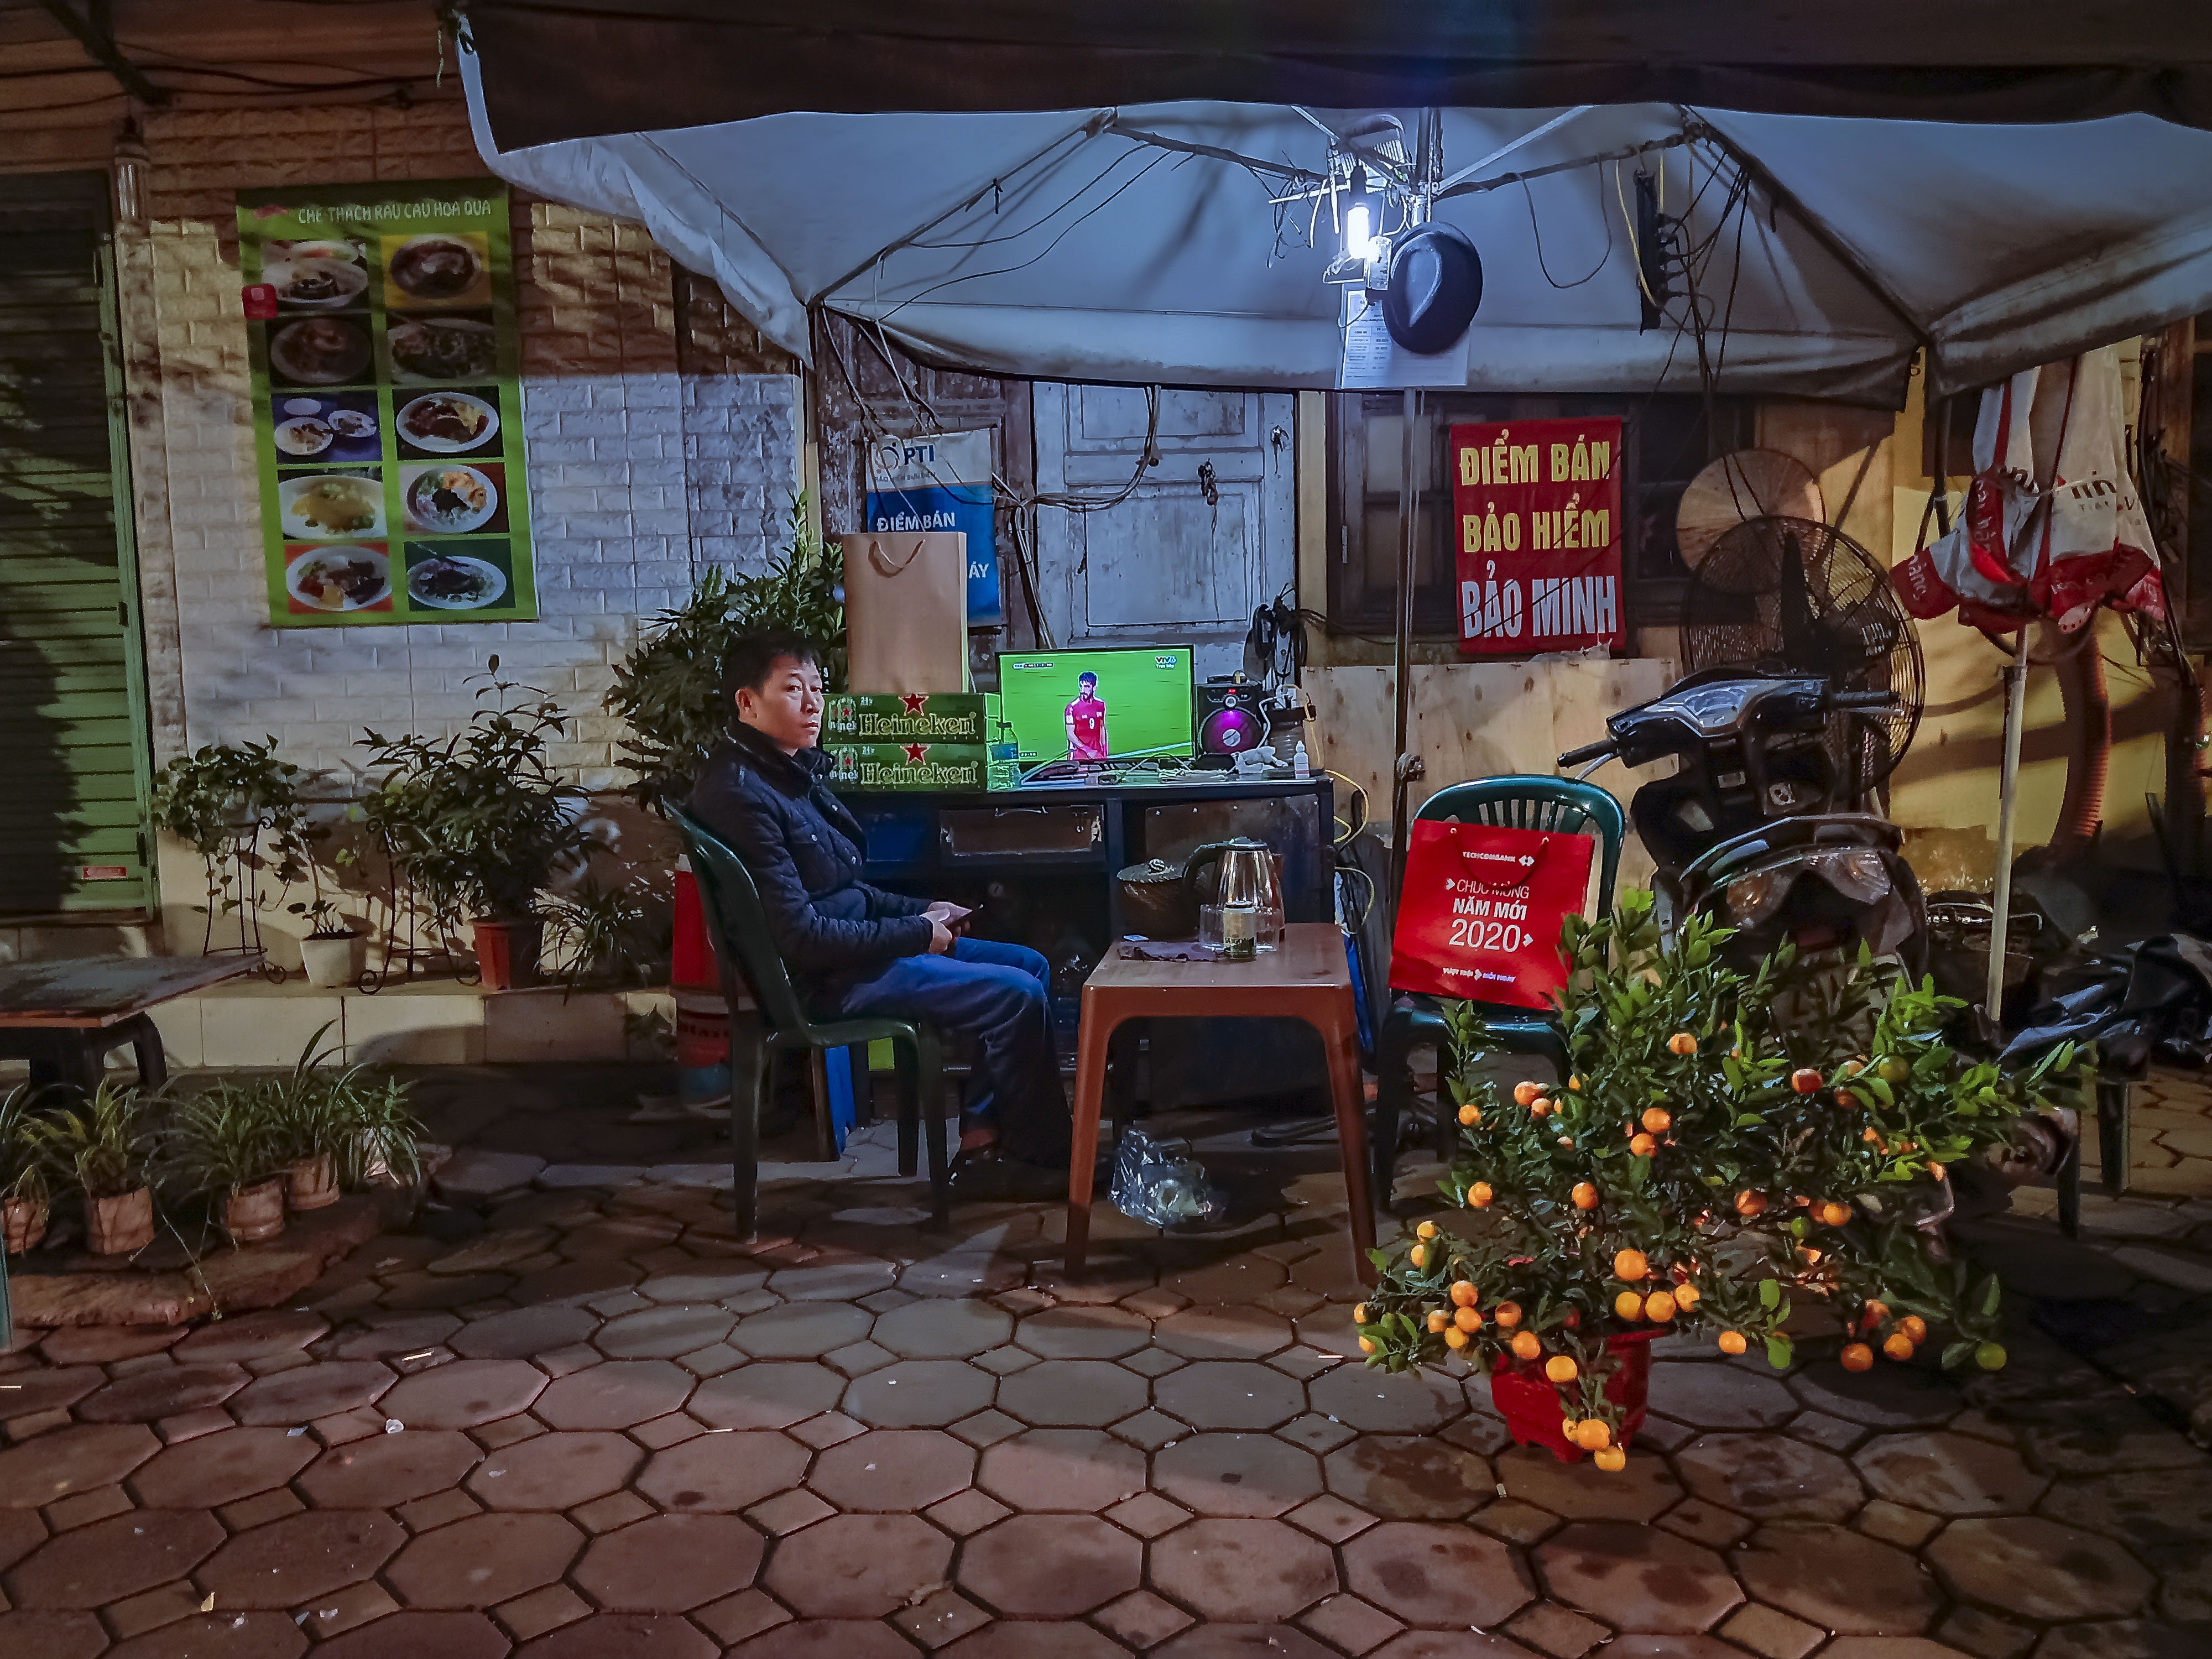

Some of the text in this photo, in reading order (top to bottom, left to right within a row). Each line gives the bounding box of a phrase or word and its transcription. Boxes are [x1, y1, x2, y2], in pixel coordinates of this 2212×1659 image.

[433, 201, 461, 217] HOA
[904, 445, 935, 466] PTI
[1459, 429, 1610, 486] ĐIỂM BÁN
[877, 509, 956, 531] ĐIỂM BÁN
[1463, 492, 1610, 552] BẢO HIỂM
[968, 561, 989, 578] ÁY
[1461, 560, 1617, 638] BẢO MINH
[858, 711, 977, 736] Heineken
[860, 760, 978, 784] Heineken
[1453, 895, 1527, 921] NĂM MỚI
[1449, 919, 1521, 952] 2020
